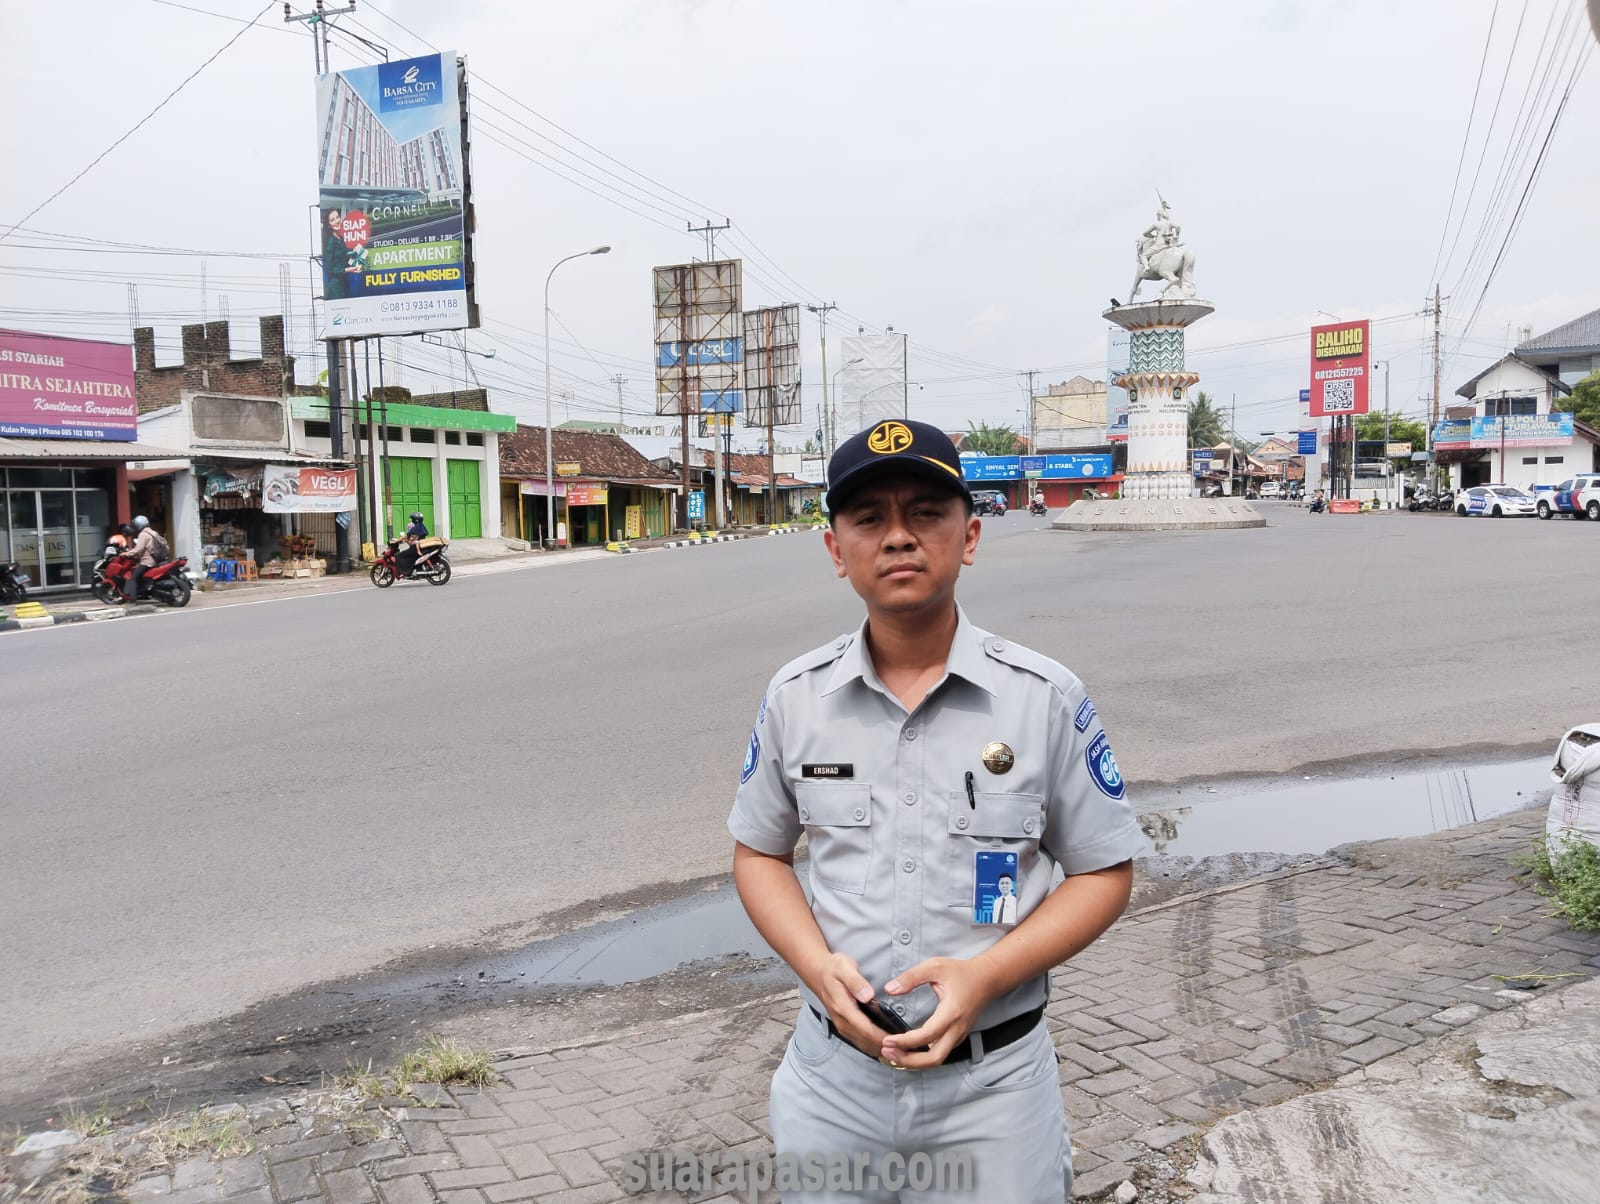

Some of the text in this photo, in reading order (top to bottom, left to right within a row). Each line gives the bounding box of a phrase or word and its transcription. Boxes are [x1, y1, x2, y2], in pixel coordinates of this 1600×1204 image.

[383, 86, 413, 97] BARSA
[415, 81, 437, 92] CITY
[343, 219, 366, 230] SIAP
[344, 230, 366, 242] HUNI
[373, 246, 453, 265] APARTMENT
[365, 268, 461, 286] FULLY FURNISHED
[390, 299, 458, 312] 0813 9334 1188
[1316, 328, 1363, 348] BALIHO
[1316, 343, 1363, 358] DISEWAKAN
[16, 351, 64, 367] SYARIAH
[46, 378, 132, 398] SEJAHTERA
[33, 397, 134, 416] Komitmen Bersyariah
[20, 427, 38, 436] Progo
[813, 767, 839, 775] ERSHAD
